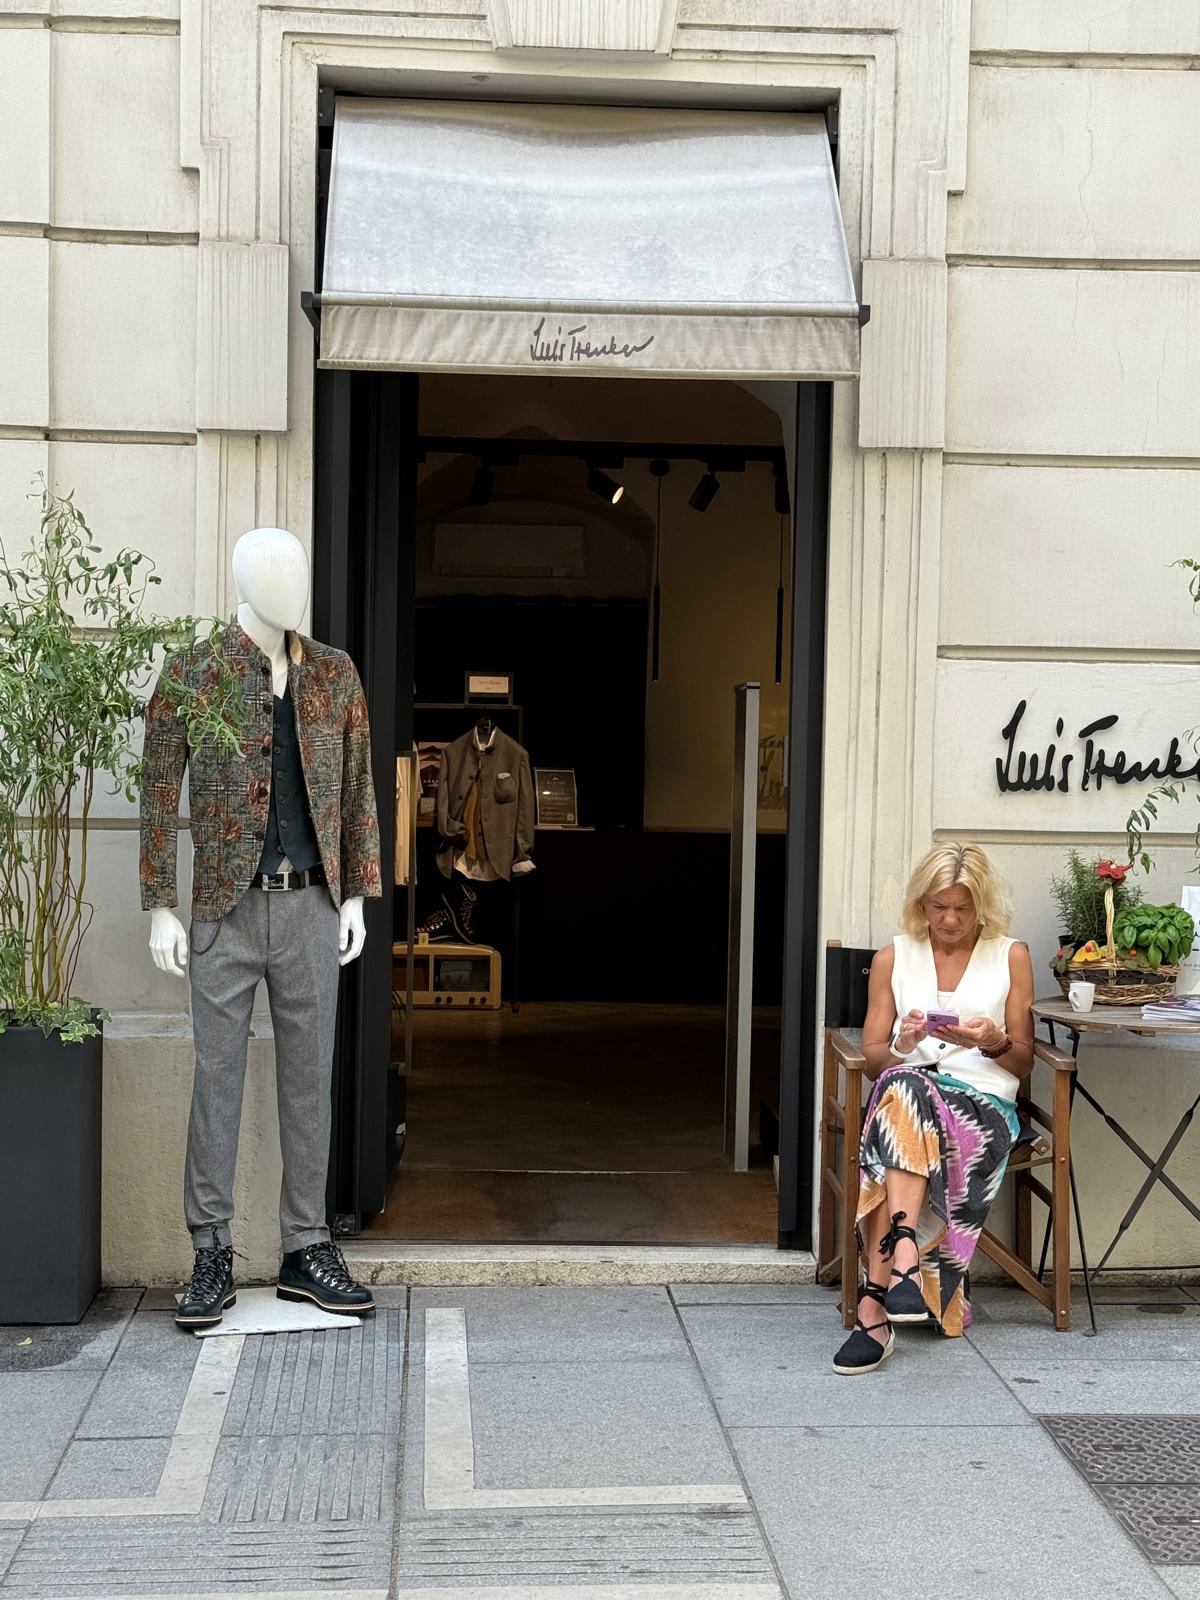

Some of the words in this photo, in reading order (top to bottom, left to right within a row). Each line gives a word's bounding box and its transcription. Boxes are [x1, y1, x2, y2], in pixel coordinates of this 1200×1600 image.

[530, 317, 566, 362] Luis
[568, 325, 655, 362] Trenker
[995, 699, 1074, 792] Luis
[1078, 715, 1200, 792] Trenk
